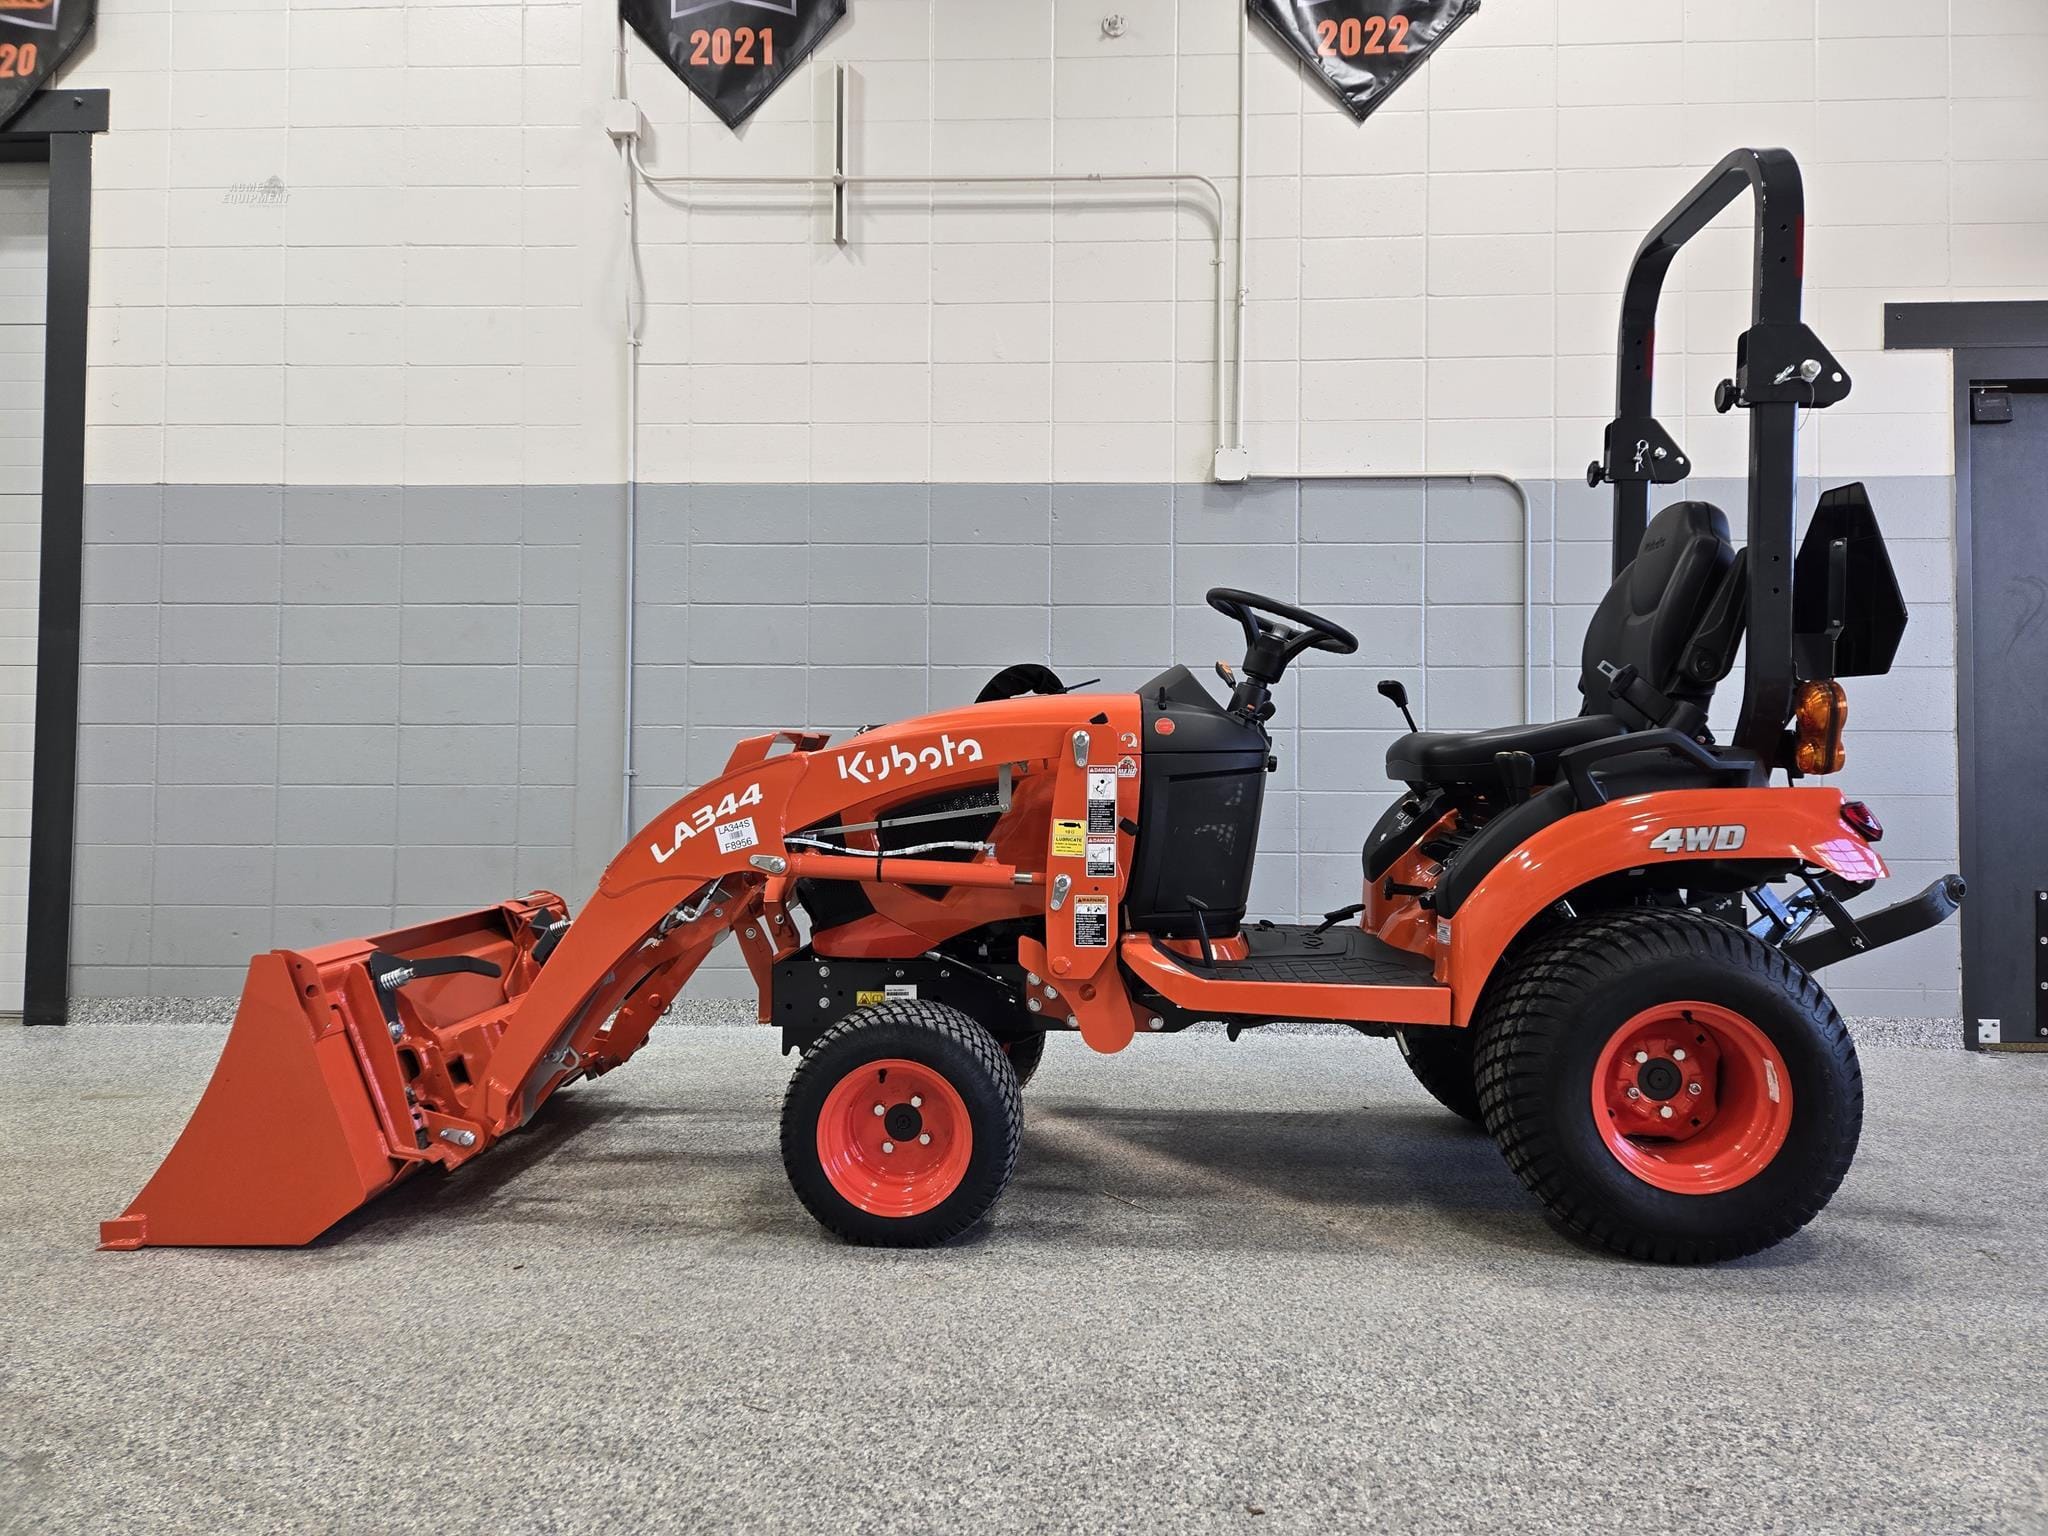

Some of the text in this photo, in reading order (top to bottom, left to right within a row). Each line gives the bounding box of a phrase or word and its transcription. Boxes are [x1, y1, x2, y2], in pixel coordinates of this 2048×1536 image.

[690, 26, 773, 65] 2021
[1317, 14, 1409, 56] 2022
[837, 734, 983, 784] Kubota
[650, 783, 763, 864] LA344
[718, 819, 751, 835] LA344S
[1649, 824, 1747, 853] 4WD
[725, 836, 753, 852] F8956
